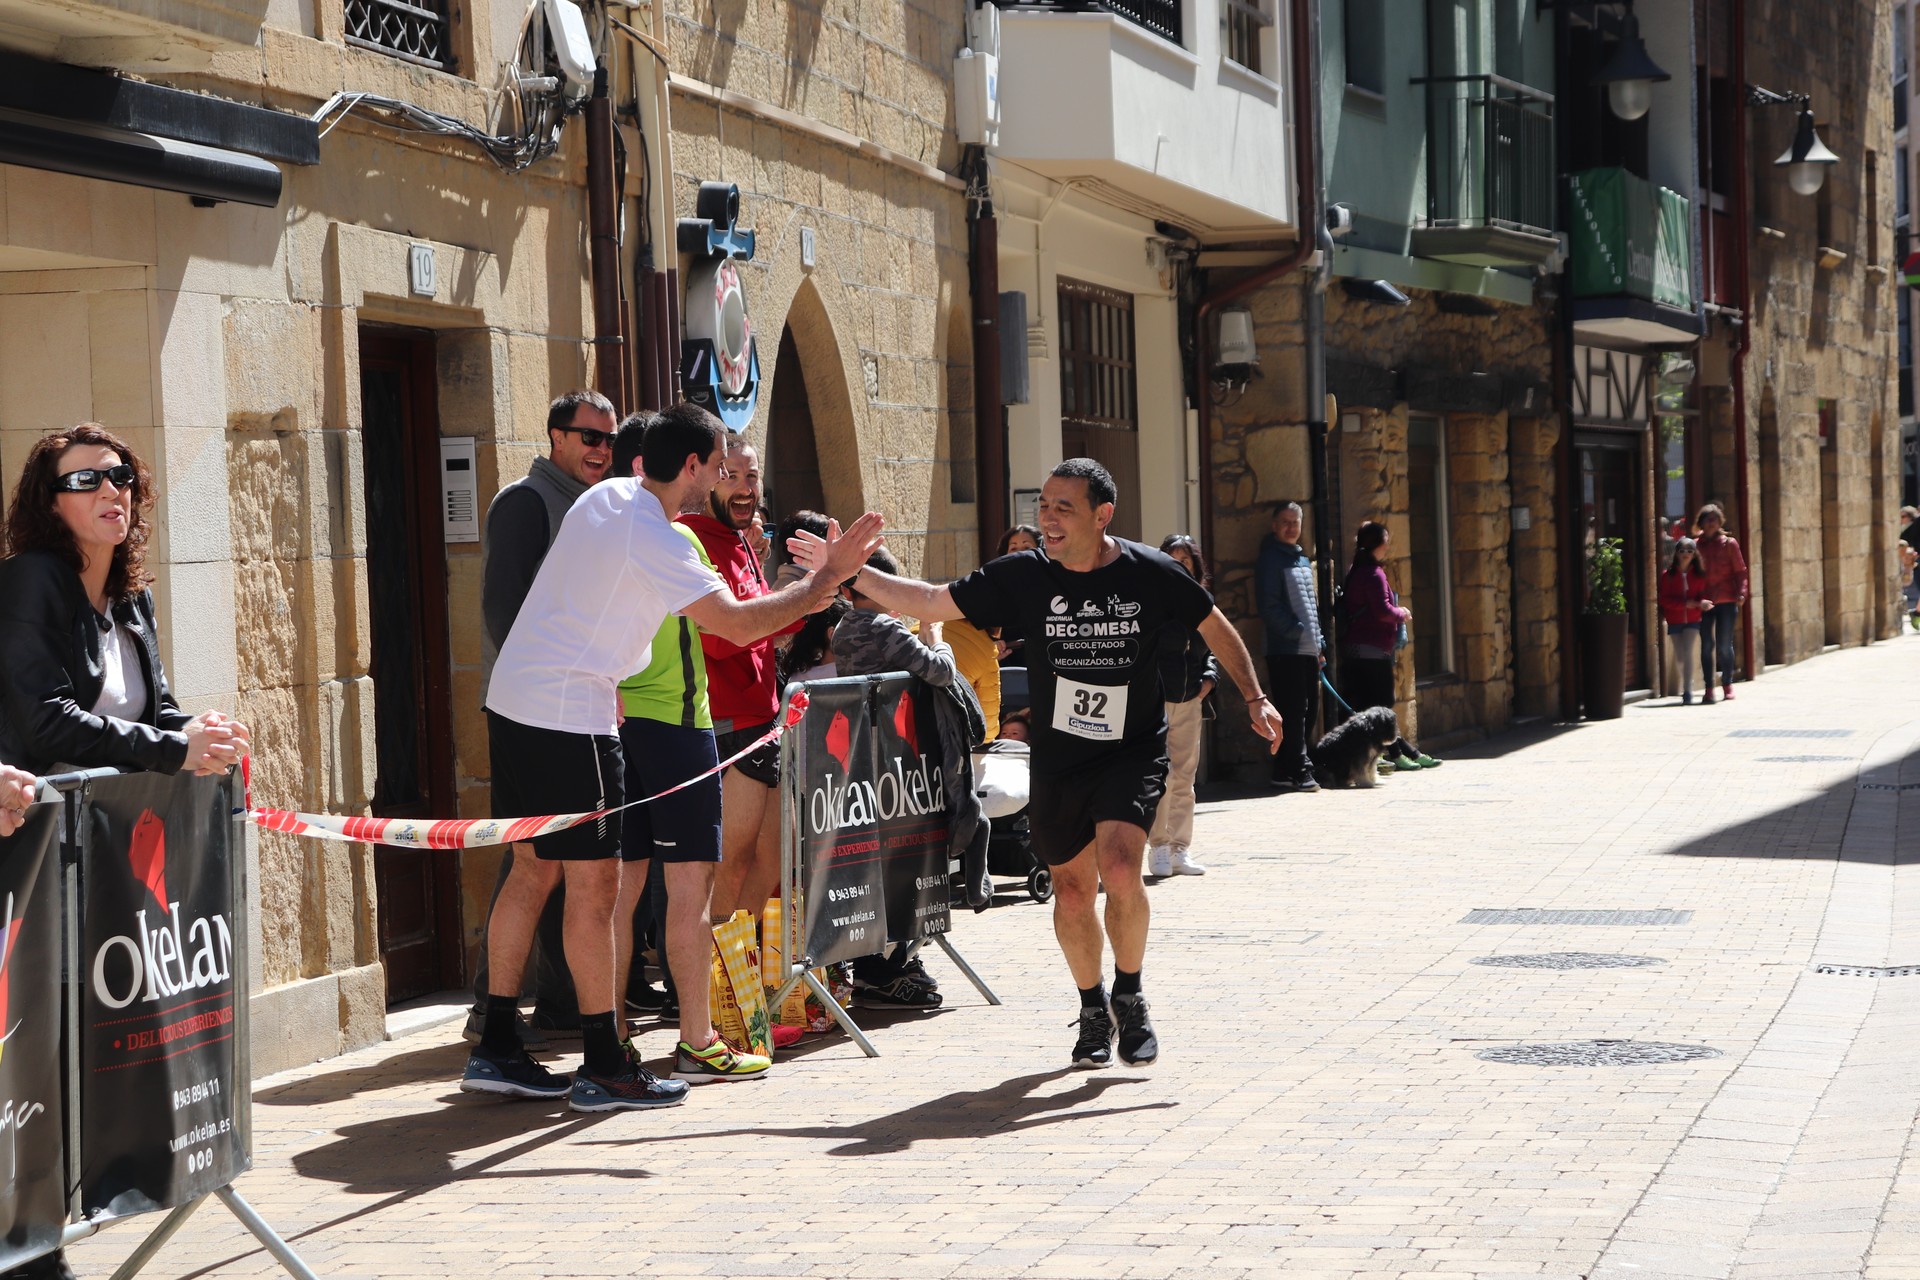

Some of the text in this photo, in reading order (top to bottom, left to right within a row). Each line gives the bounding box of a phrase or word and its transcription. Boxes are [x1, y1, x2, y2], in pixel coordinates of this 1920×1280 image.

[804, 233, 814, 261] 21
[415, 252, 432, 288] 19
[1045, 620, 1140, 637] DECOMESA
[1062, 640, 1125, 650] DECOLETADOS
[1054, 658, 1116, 666] MECANIZADOS,
[1073, 689, 1108, 719] 32
[1070, 719, 1105, 732] Gipuzkoa
[836, 889, 849, 901] 943
[849, 886, 858, 898] 89
[832, 910, 876, 928] www.okelan.es
[895, 983, 916, 1001] N
[127, 1020, 184, 1051] DELICIOUS
[191, 1084, 202, 1103] 89
[209, 1077, 220, 1096] 11
[169, 1117, 231, 1153] www.okelan.es
